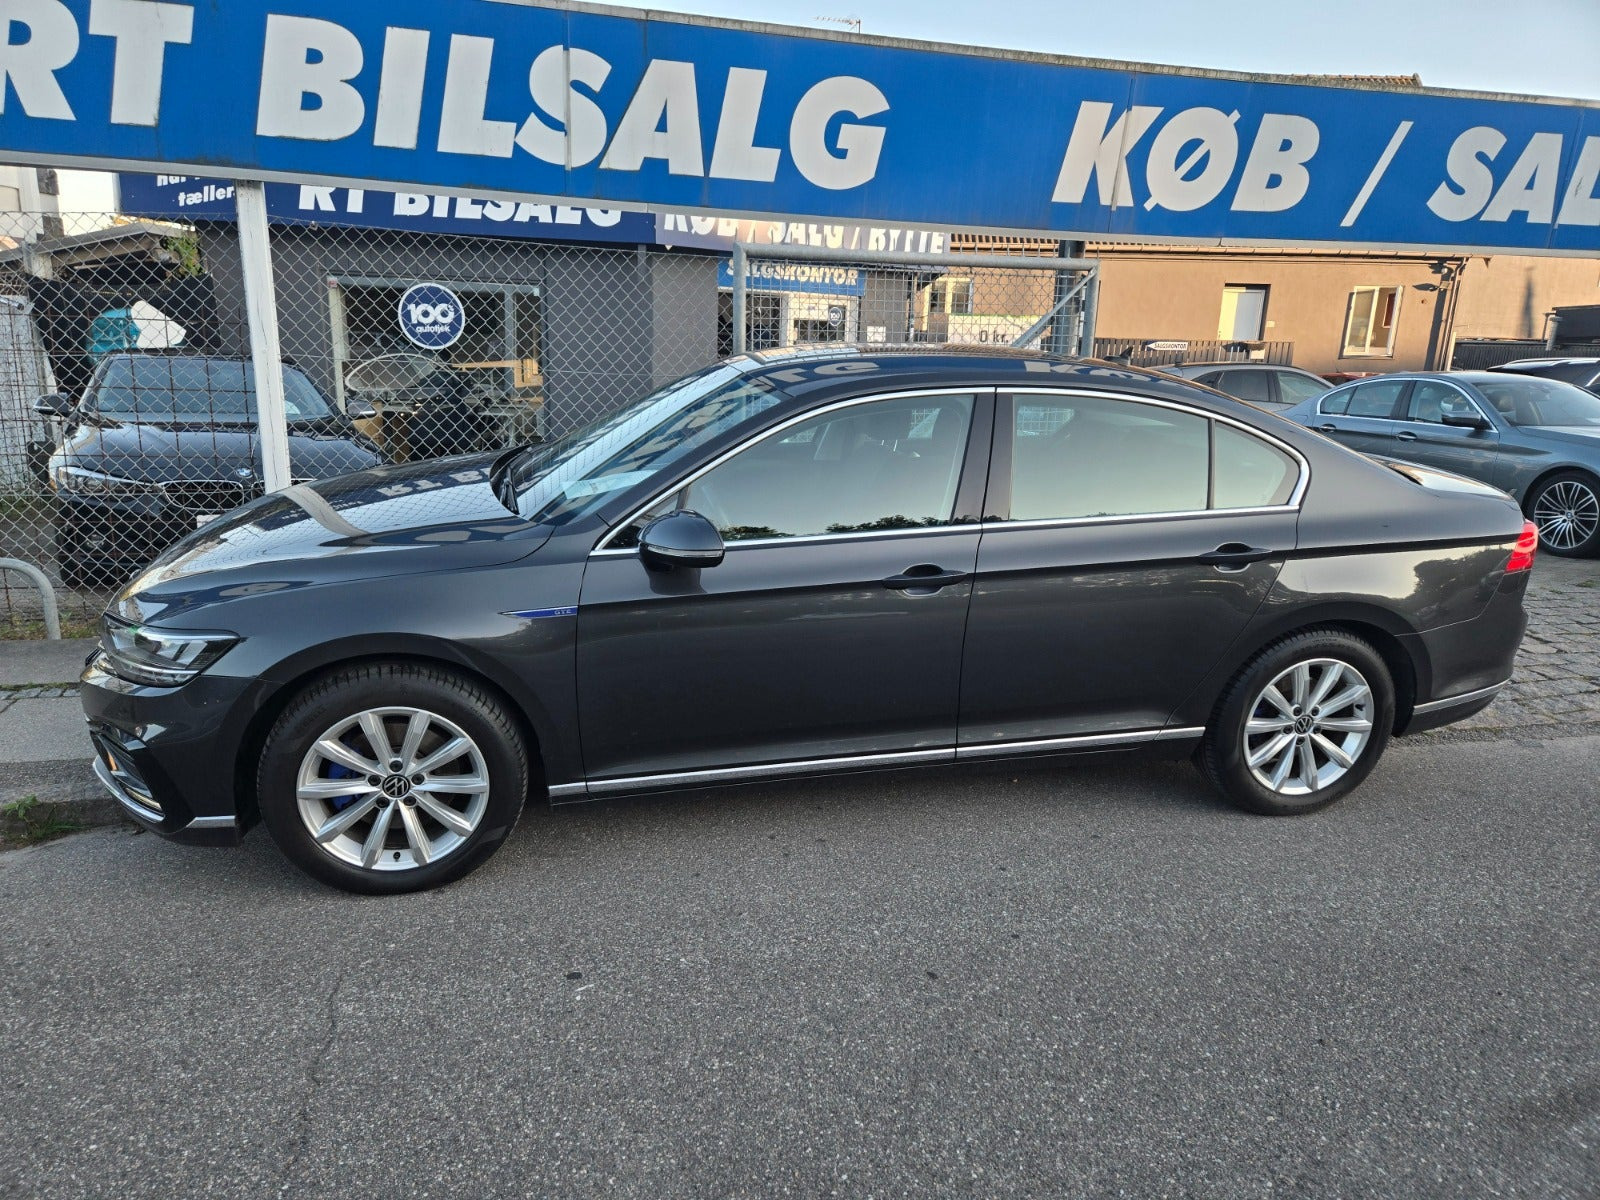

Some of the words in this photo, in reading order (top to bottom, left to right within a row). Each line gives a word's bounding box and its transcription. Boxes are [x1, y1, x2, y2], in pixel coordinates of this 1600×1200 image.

[256, 14, 891, 190] BILSALG
[1052, 101, 1319, 213] KØB
[1340, 121, 1413, 227] /
